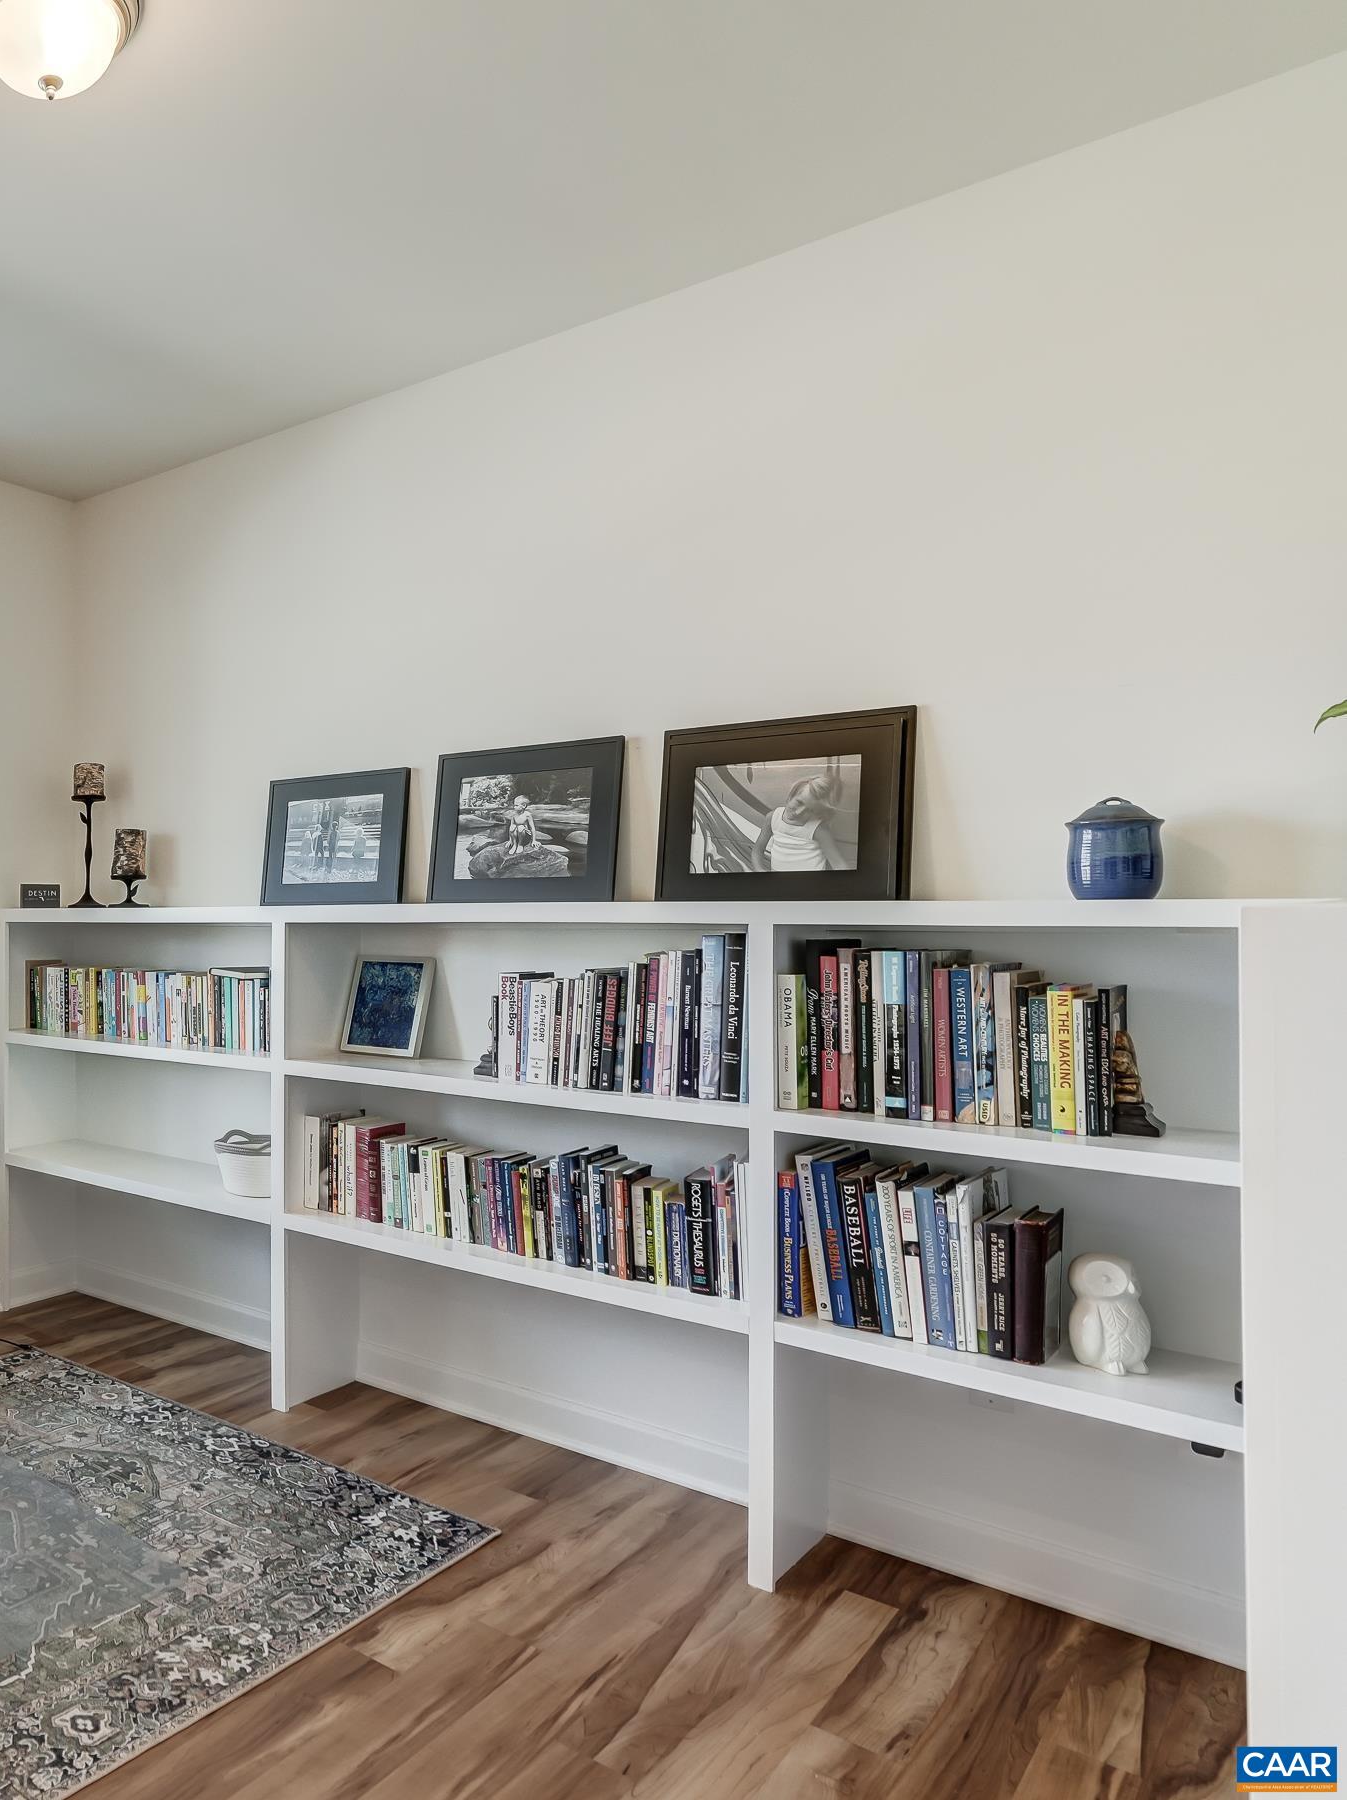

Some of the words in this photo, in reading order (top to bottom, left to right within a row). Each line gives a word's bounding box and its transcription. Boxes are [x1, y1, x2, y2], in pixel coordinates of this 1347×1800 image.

[705, 953, 715, 977] THE
[824, 969, 833, 988] John
[501, 976, 509, 1000] Book
[729, 961, 739, 1003] Leonardo
[606, 979, 617, 1021] BRIDGES
[703, 979, 714, 1016] GREAT
[729, 1004, 736, 1014] da
[783, 988, 792, 1028] OBAMA
[807, 988, 818, 1015] Prom
[956, 987, 967, 1034] WESTERN
[1058, 994, 1068, 1007] IN
[646, 1003, 656, 1031] FEMINIST
[728, 1016, 738, 1039] Vinci
[1058, 1011, 1069, 1034] THE
[594, 1017, 602, 1047] HEALING
[603, 1025, 614, 1046] JEFF
[646, 1032, 654, 1043] ART
[702, 1017, 714, 1067] MASTERS
[824, 1020, 834, 1056] Director's
[1018, 1026, 1028, 1039] Joy
[1020, 1041, 1028, 1049] of
[958, 1036, 968, 1057] ART
[1032, 1033, 1040, 1061] CHOICES
[826, 1058, 834, 1071] Cut
[938, 1049, 946, 1077] ARTISTS
[1020, 1050, 1030, 1099] Photography
[1059, 1040, 1071, 1088] MAKING
[882, 1186, 891, 1199] 200
[884, 1200, 893, 1223] YEARS
[903, 1208, 913, 1224] LIFE
[843, 1185, 864, 1267] BASEBALL
[887, 1224, 894, 1232] OF
[646, 1236, 654, 1267] BLINDSPOT
[672, 1231, 681, 1278] DICTIONARY
[693, 1222, 703, 1267] THESAURUS
[784, 1237, 793, 1273] BUSINESS
[826, 1229, 843, 1280] BASEBALL
[888, 1234, 898, 1254] SPORT
[924, 1230, 935, 1275] CONTAINER
[938, 1220, 948, 1276] COTTAGE
[891, 1256, 899, 1264] IN
[785, 1274, 794, 1300] PLANS
[892, 1265, 903, 1299] AMERICA
[953, 1269, 961, 1293] SHELVES
[928, 1276, 940, 1321] GARDENING
